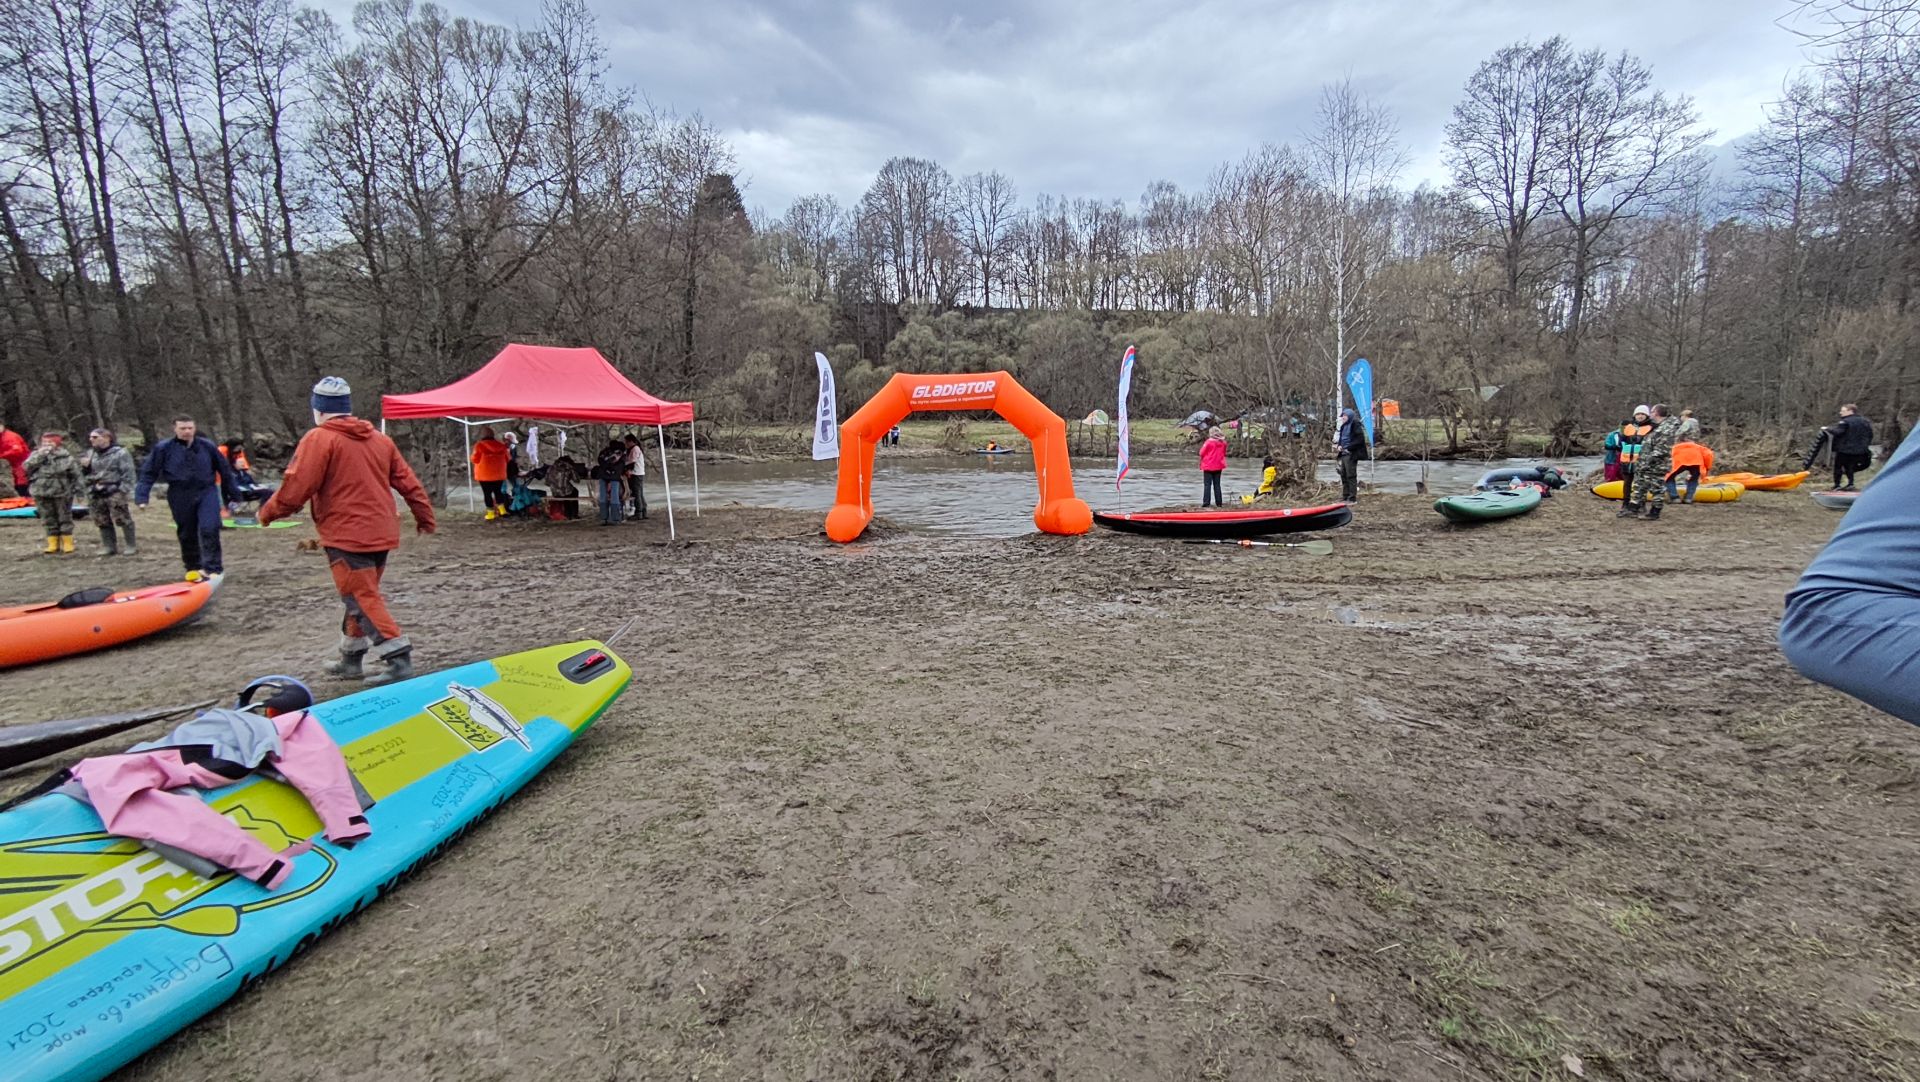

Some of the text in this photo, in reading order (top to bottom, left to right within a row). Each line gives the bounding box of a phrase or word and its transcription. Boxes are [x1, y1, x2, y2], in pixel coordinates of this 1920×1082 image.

[98, 941, 234, 1024] Баренцево
[6, 1011, 66, 1052] 2021
[42, 1024, 87, 1053] море
